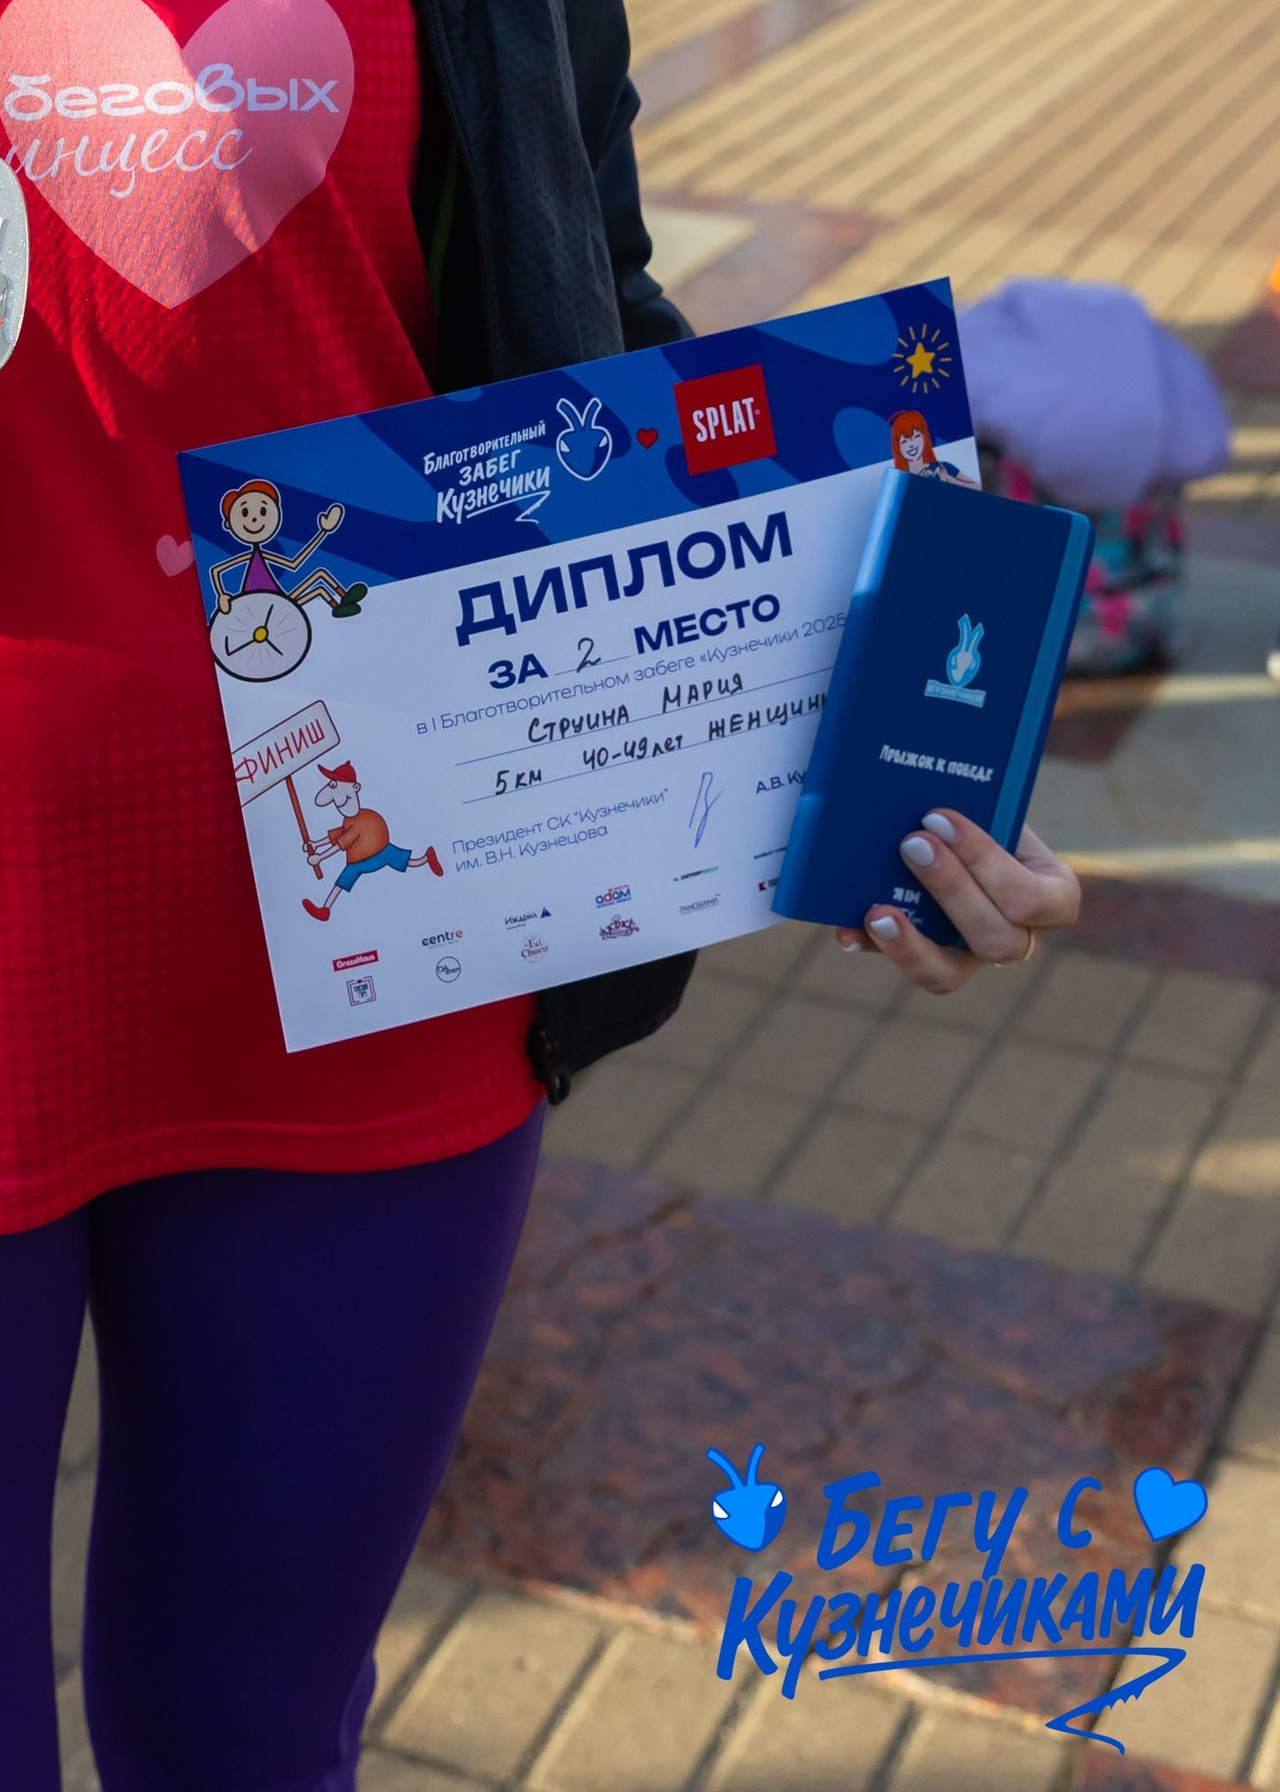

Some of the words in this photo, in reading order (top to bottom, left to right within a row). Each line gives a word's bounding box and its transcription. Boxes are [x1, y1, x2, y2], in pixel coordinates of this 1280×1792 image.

[3, 63, 340, 122] беговых
[692, 397, 756, 443] SPLAT
[459, 449, 521, 486] ЗАБЕГ
[436, 465, 551, 524] Кузнечики
[455, 510, 793, 647] ДИПЛОМ
[487, 653, 549, 689] ЗА
[576, 637, 601, 673] 2
[633, 594, 781, 655] МЕСТО
[416, 722, 428, 735] в
[439, 672, 631, 729] Благотворительном
[633, 654, 696, 682] забеге
[699, 628, 800, 663] «Кузнечики
[234, 718, 326, 784] ФИНИШ
[495, 769, 510, 796] 5
[451, 821, 544, 854] Президент
[546, 814, 572, 831] СК
[455, 859, 483, 873] им.
[518, 825, 608, 856] Кузнецова
[335, 953, 376, 970] GrossHaus
[421, 929, 463, 947] centre
